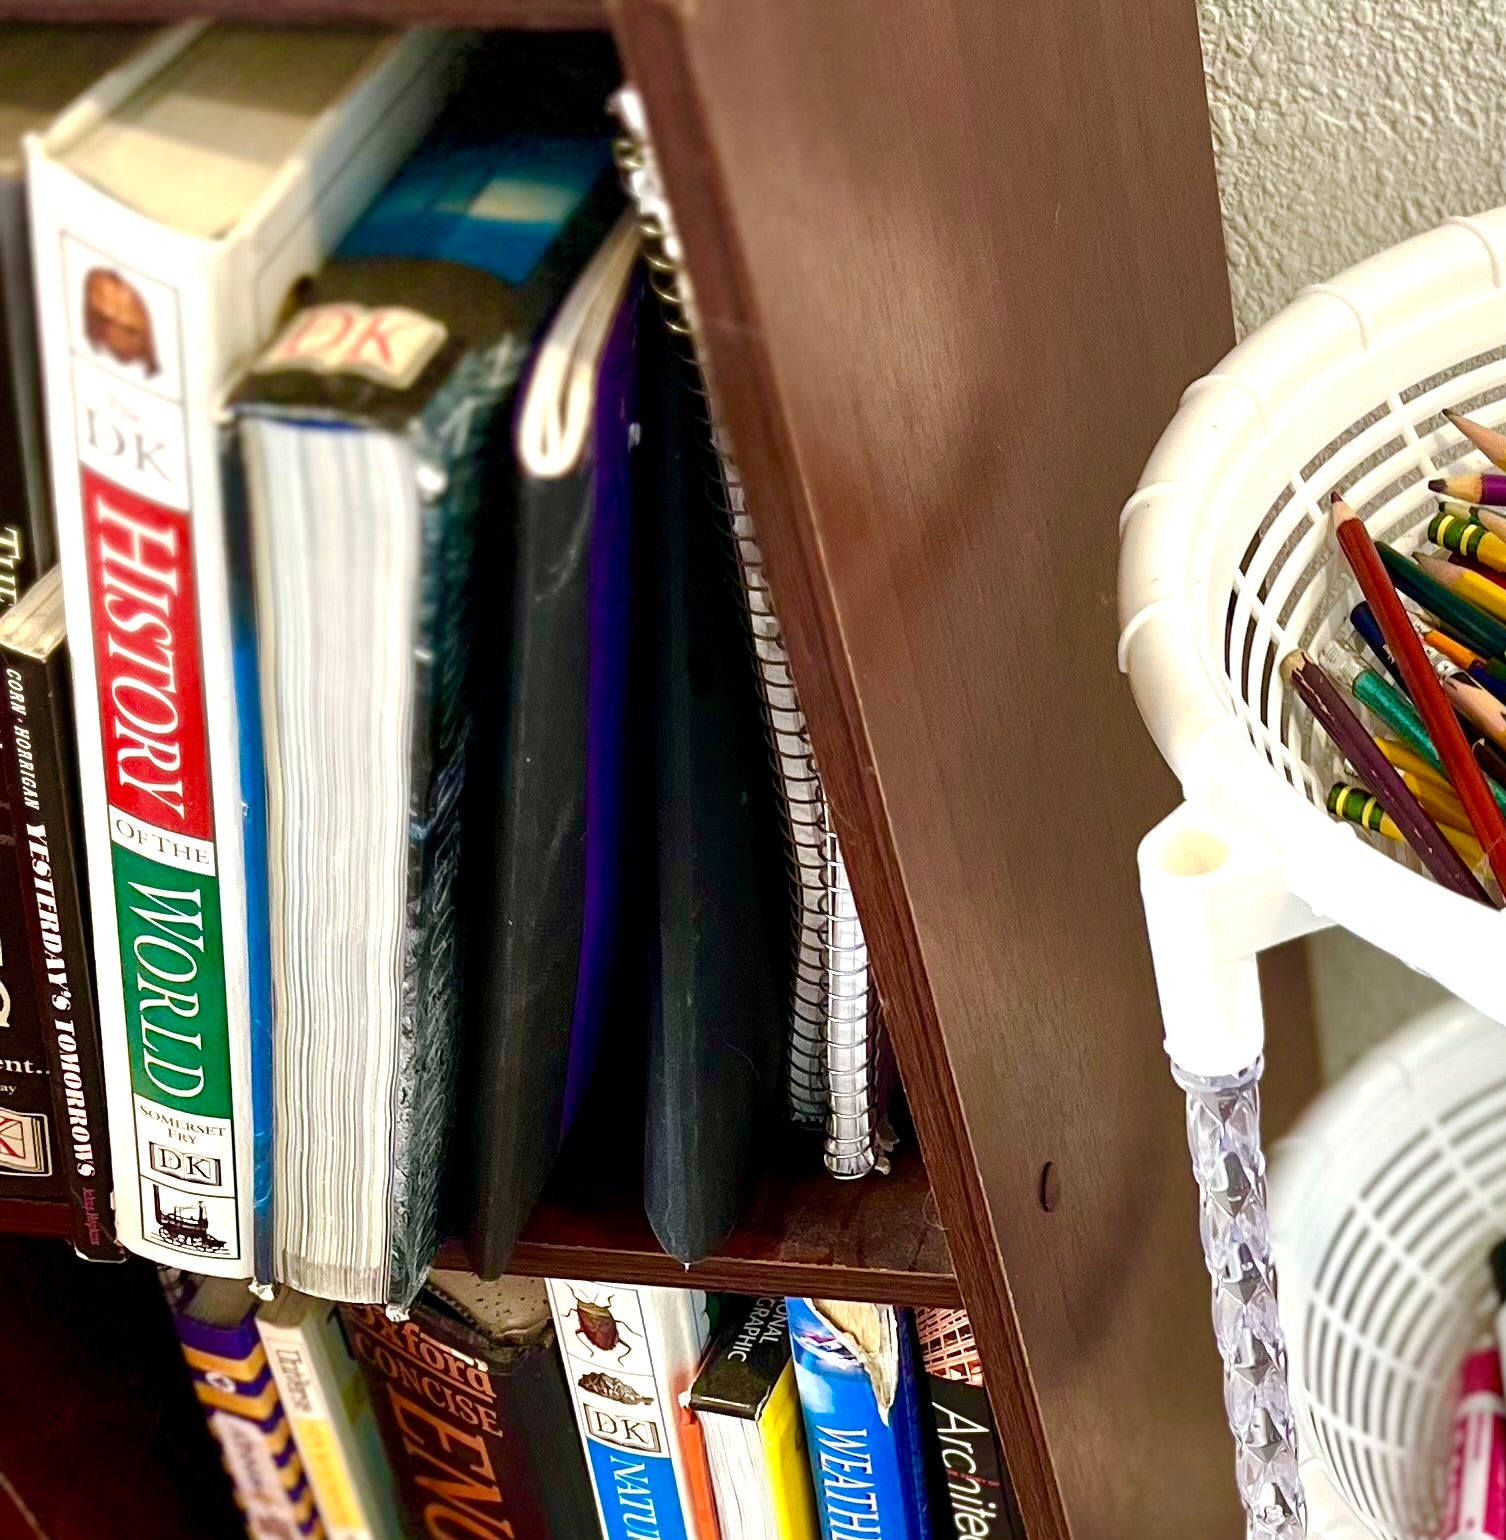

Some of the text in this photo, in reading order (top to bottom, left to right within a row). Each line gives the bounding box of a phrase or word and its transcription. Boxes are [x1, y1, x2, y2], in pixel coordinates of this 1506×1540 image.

[84, 406, 175, 484] DK
[97, 493, 186, 820] HISTORY
[6, 668, 40, 811] CORN HORRIGAN
[151, 833, 210, 864] THE
[26, 823, 96, 1177] YESTERDAY'S TOMORROWS
[127, 881, 205, 1098] WORLD
[140, 1105, 227, 1137] SOMERSET
[167, 1127, 198, 1145] FRY
[157, 1147, 212, 1180] DK
[759, 1299, 788, 1344] ONAL
[354, 1332, 504, 1438] CONCISE
[594, 1411, 648, 1445] DK
